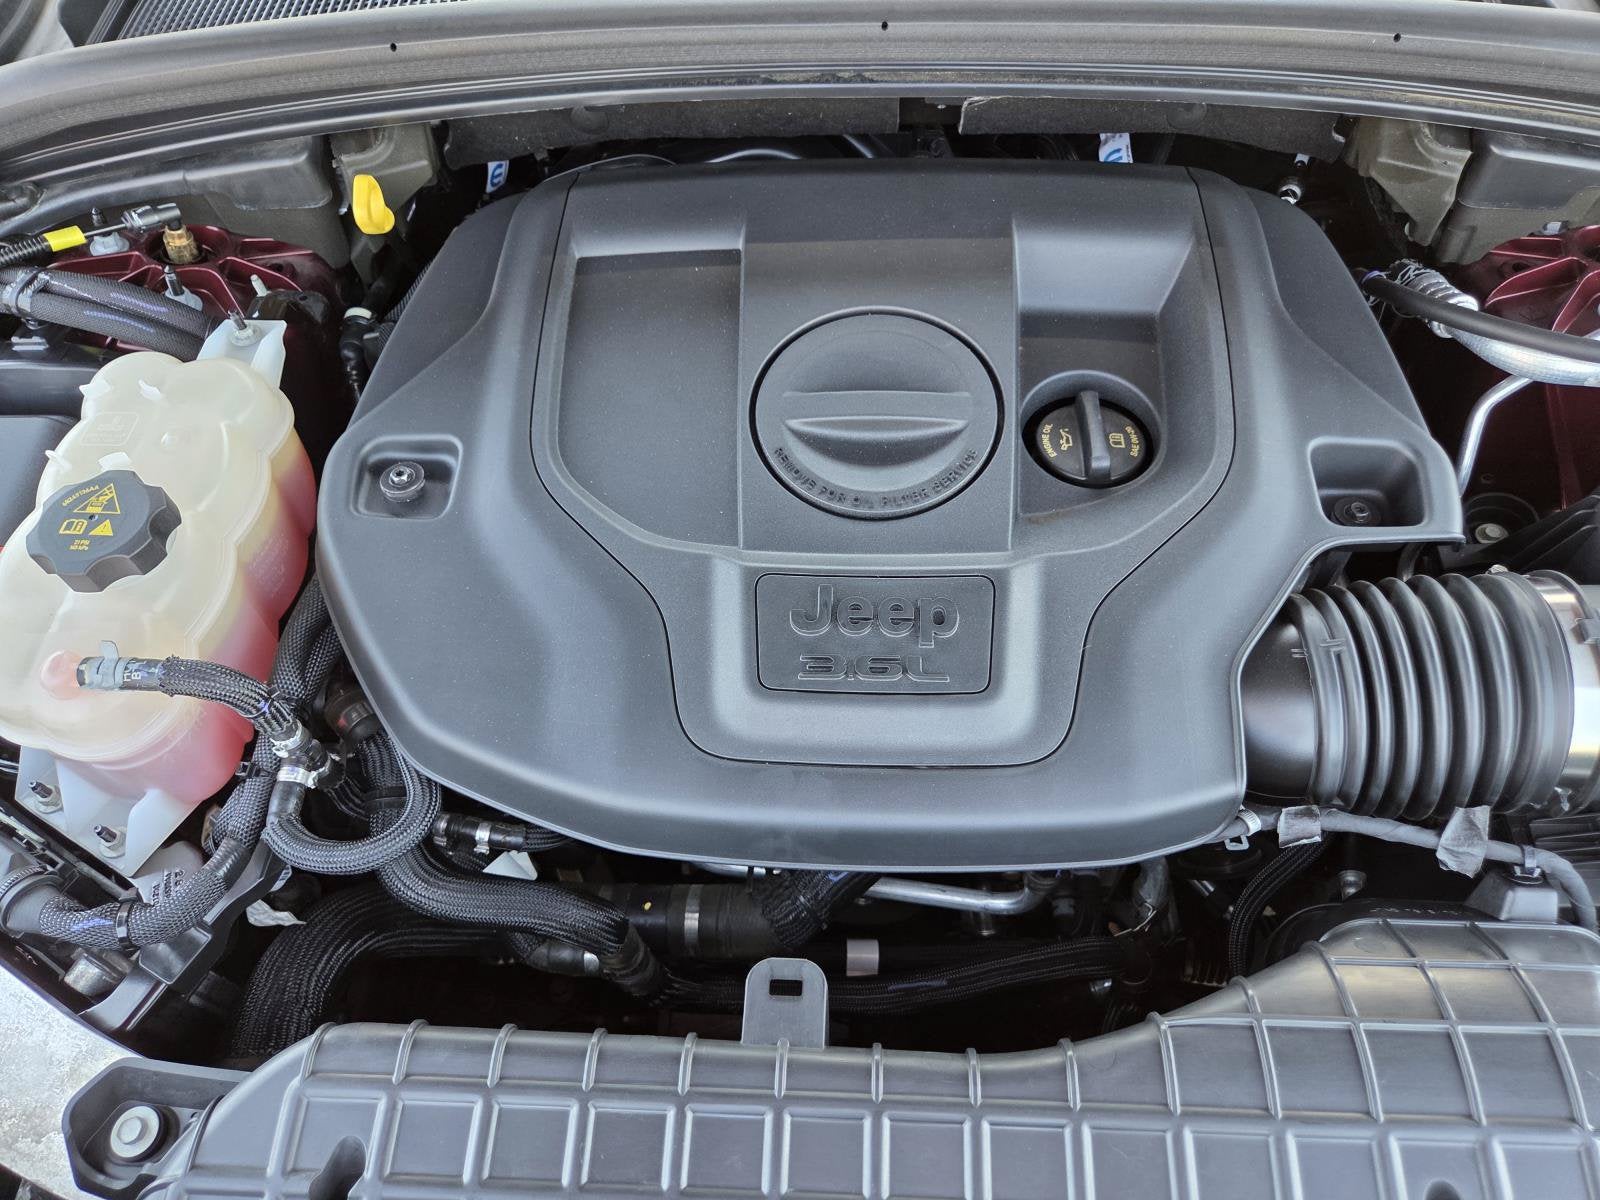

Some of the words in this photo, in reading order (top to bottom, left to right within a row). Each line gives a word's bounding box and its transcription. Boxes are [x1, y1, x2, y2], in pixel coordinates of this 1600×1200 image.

[1042, 423, 1054, 434] OIL
[1041, 434, 1058, 458] ENGINE
[1129, 444, 1140, 457] SAE
[773, 448, 818, 491] REMOVE
[789, 583, 960, 649] Jeep
[797, 653, 950, 682] 3.6L
